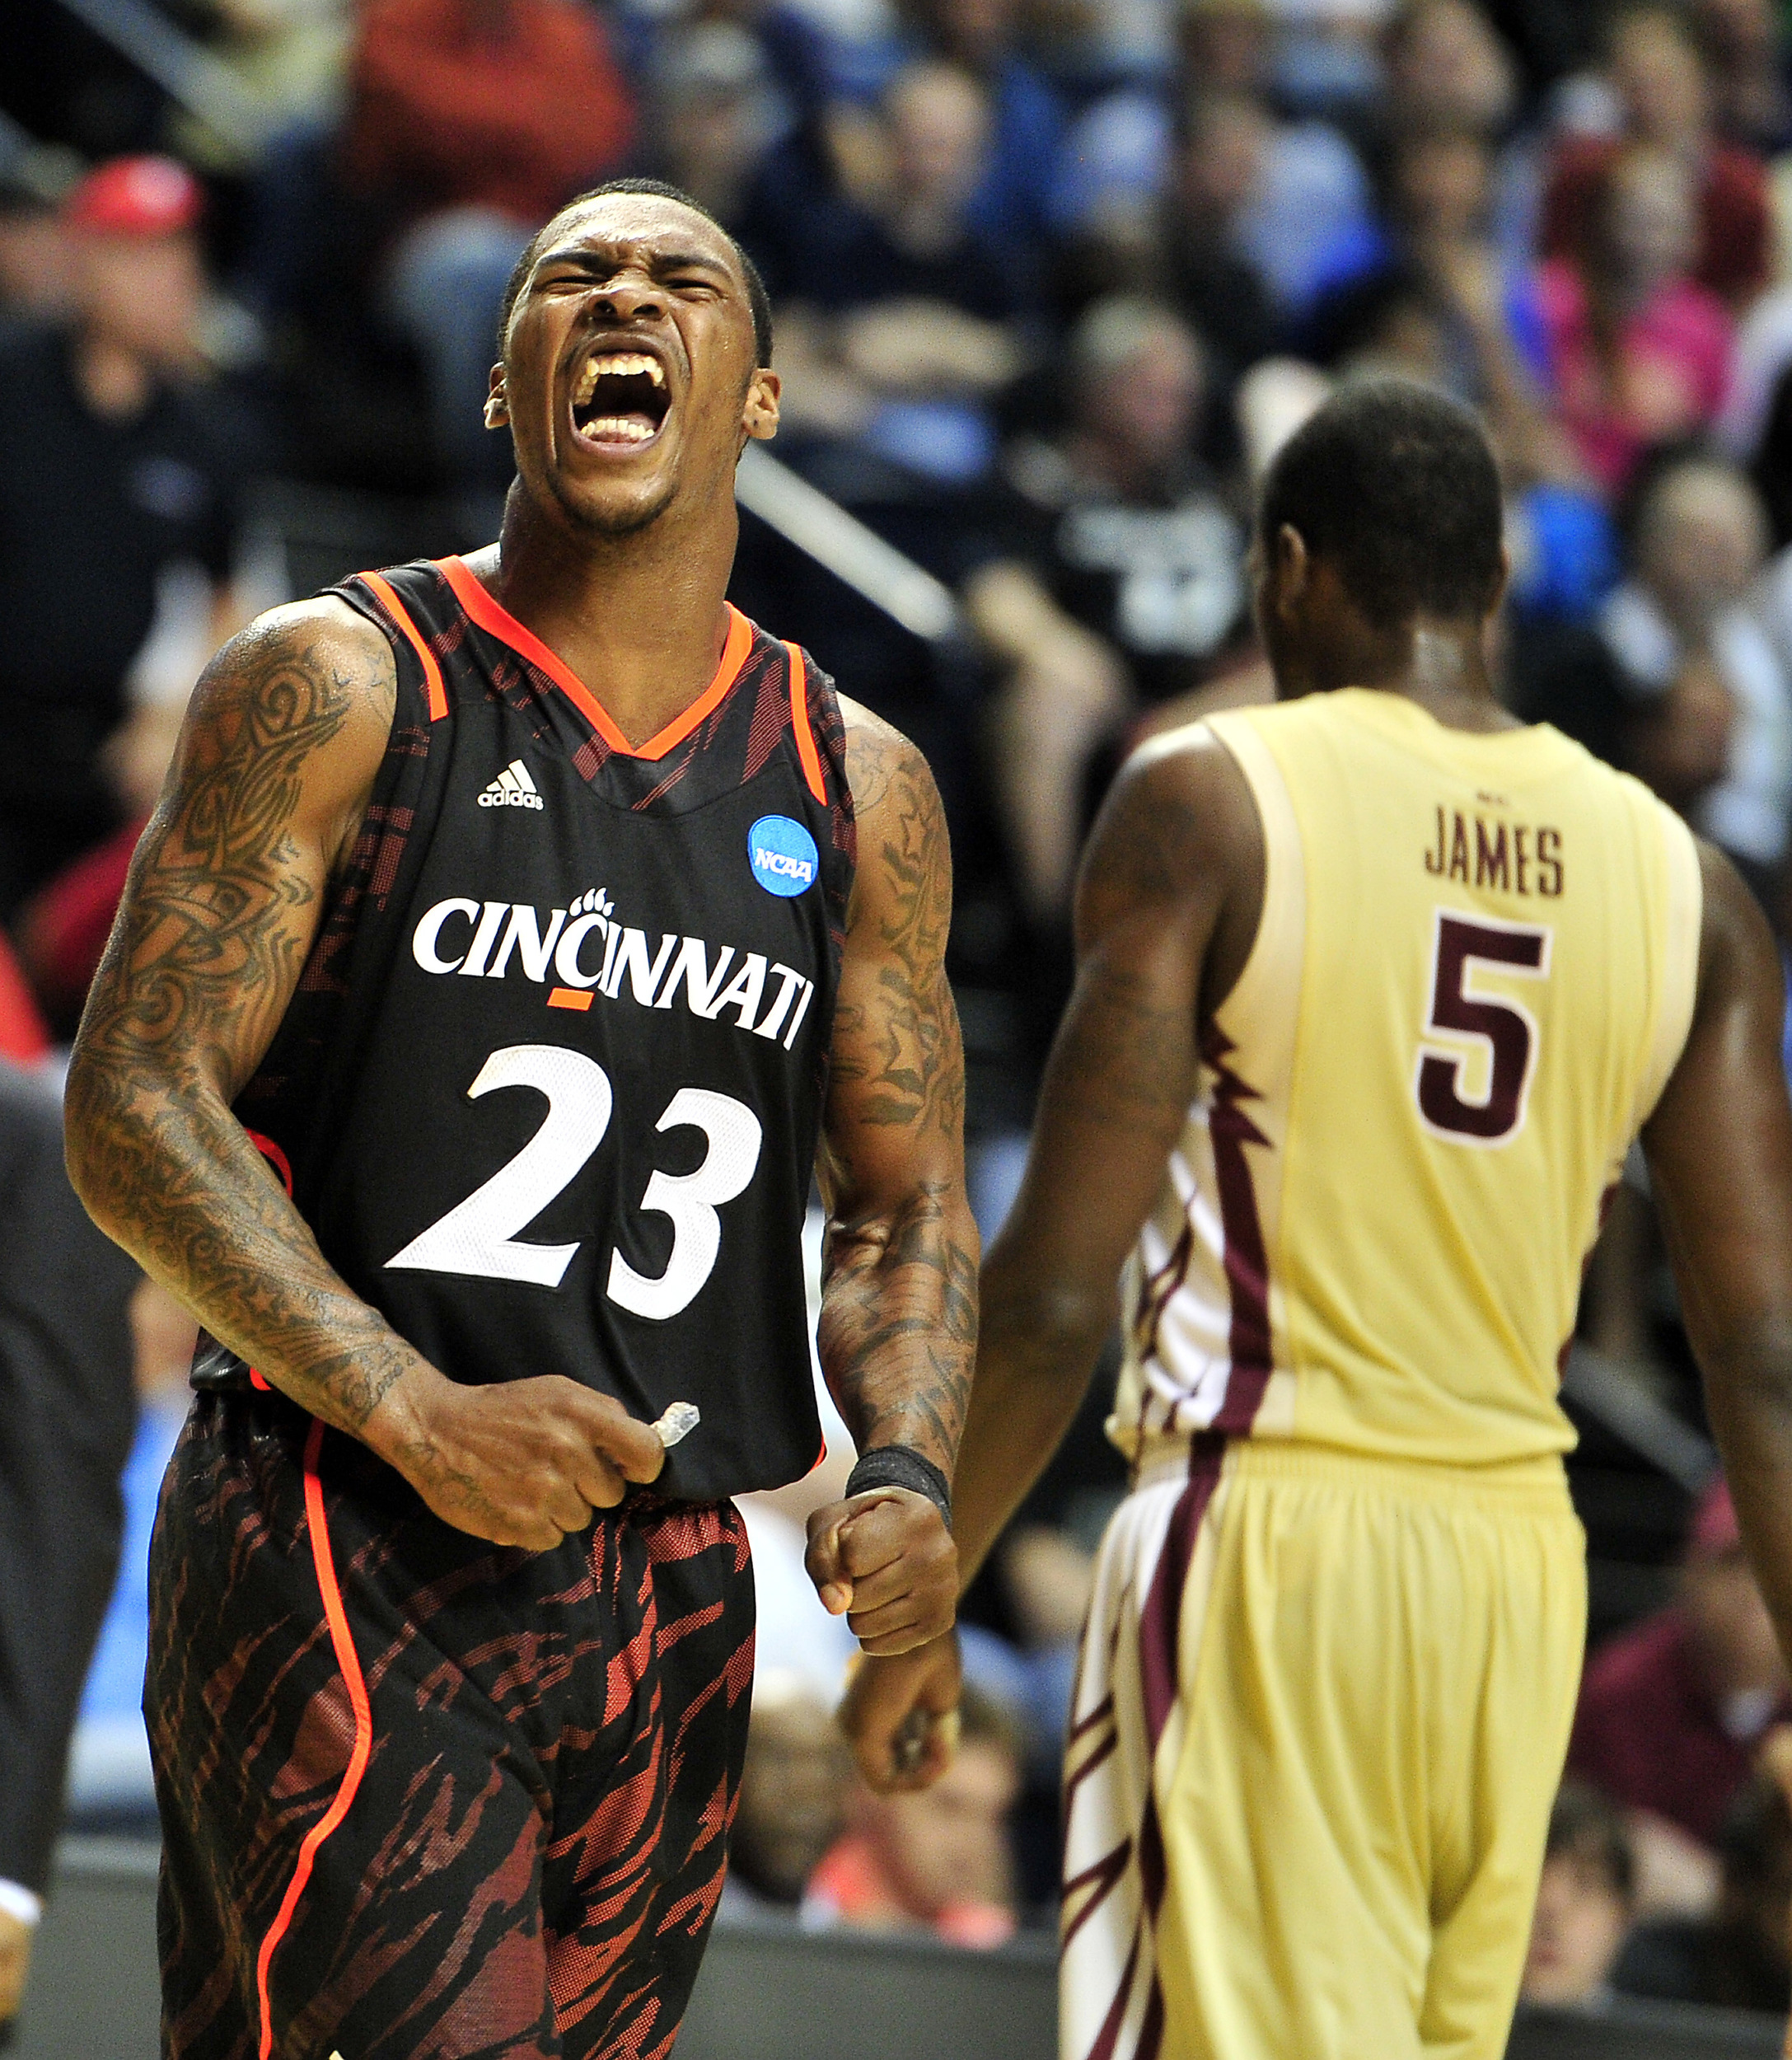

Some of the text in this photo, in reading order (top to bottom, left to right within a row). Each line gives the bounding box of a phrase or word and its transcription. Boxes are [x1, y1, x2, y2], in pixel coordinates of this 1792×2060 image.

[477, 789, 544, 811] adidas
[1424, 803, 1564, 900] JAMES
[754, 847, 812, 883] NCAA
[412, 897, 814, 1051] CINCINNATI
[1415, 906, 1554, 1149] 5
[381, 1043, 763, 1320] 23
